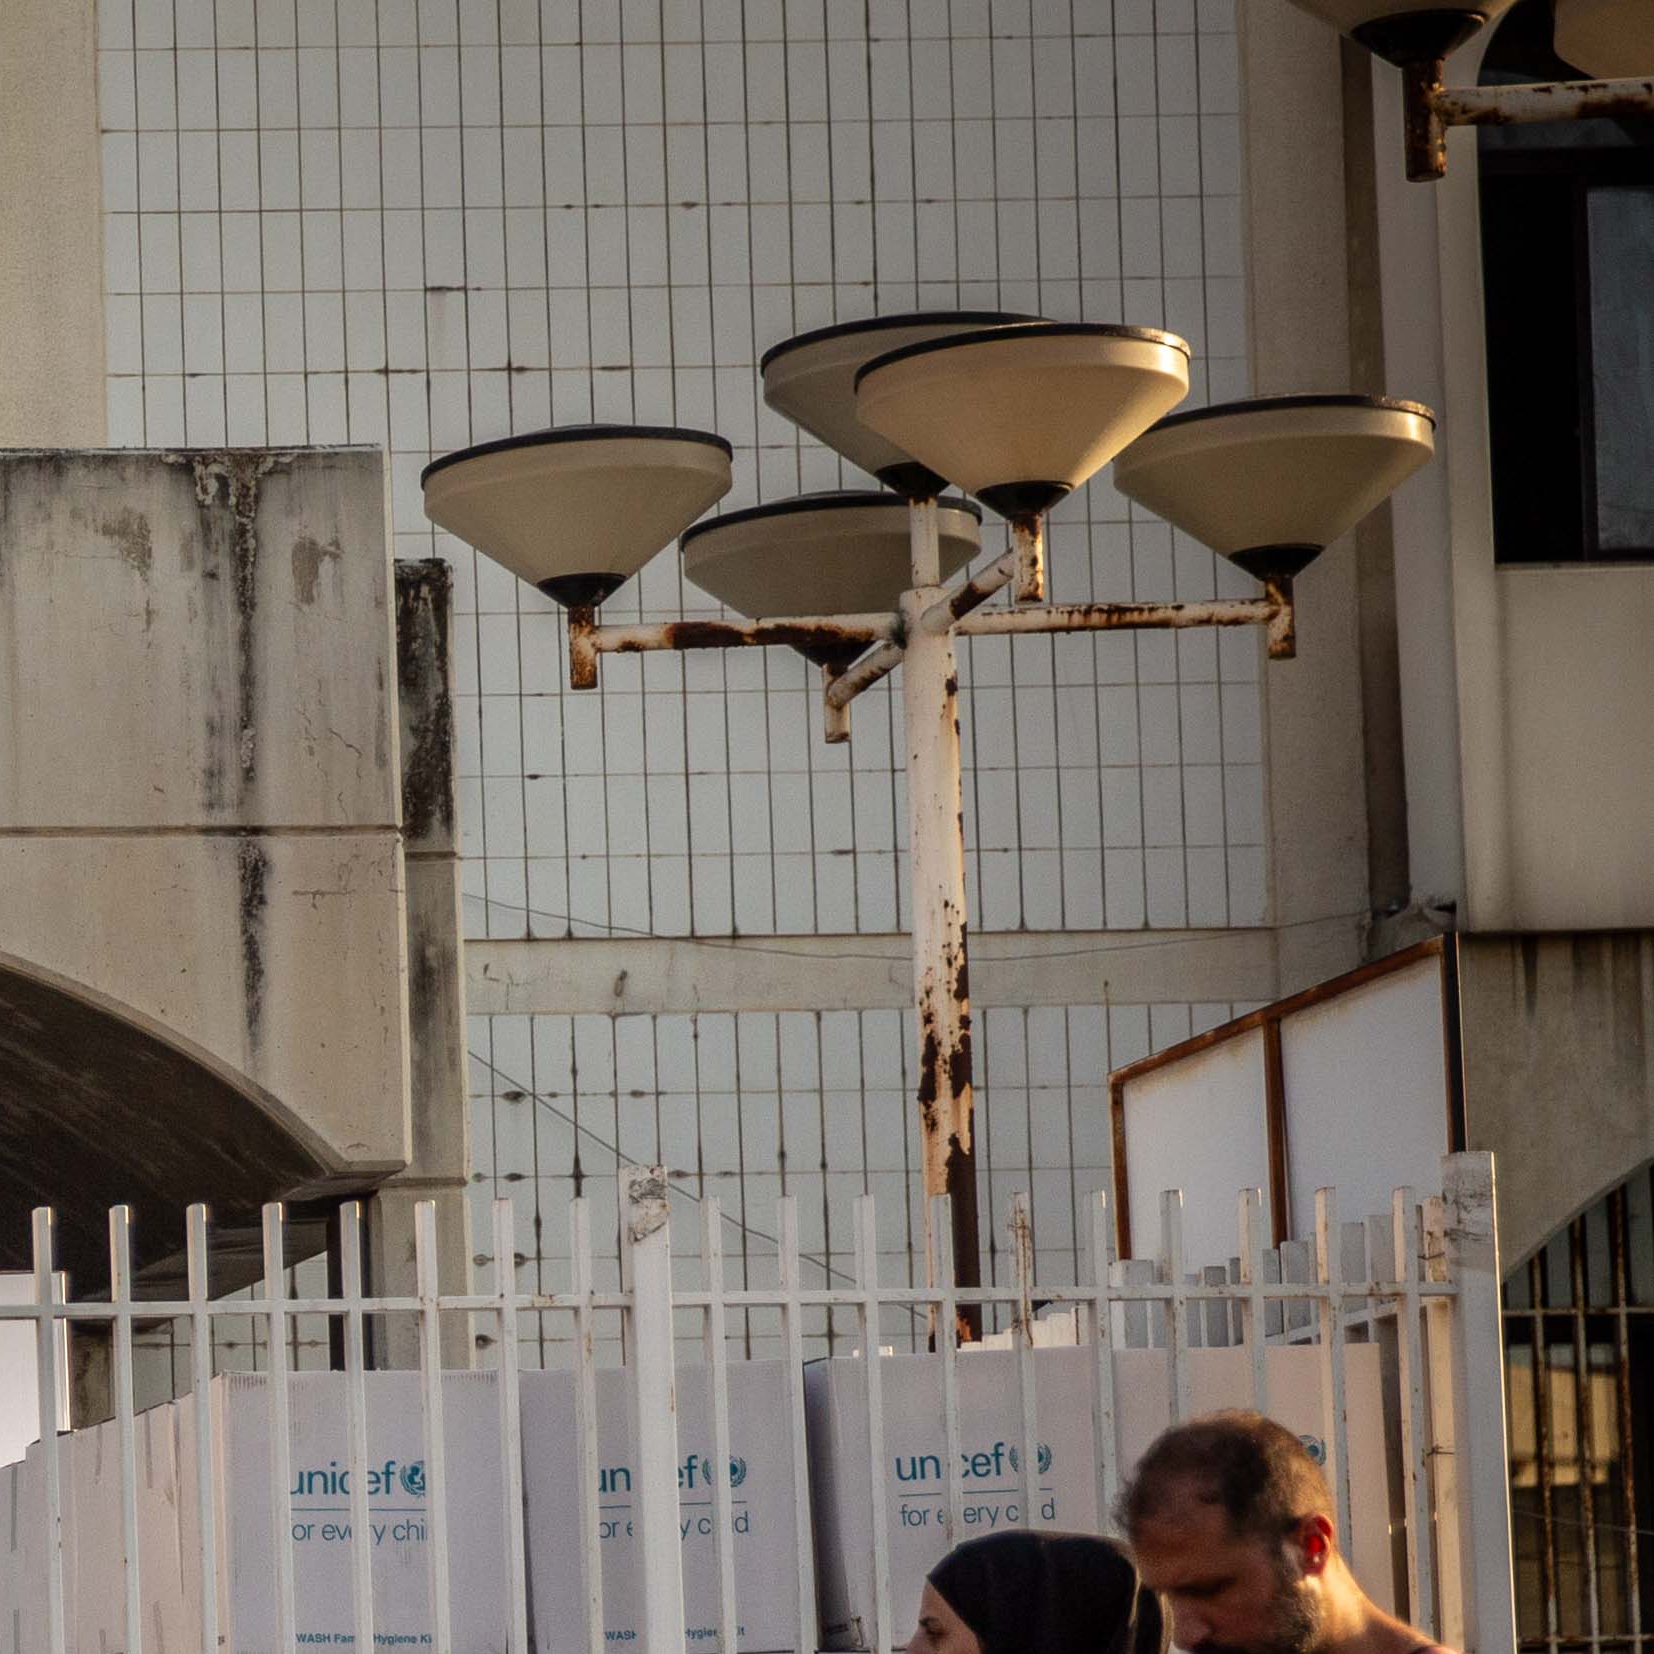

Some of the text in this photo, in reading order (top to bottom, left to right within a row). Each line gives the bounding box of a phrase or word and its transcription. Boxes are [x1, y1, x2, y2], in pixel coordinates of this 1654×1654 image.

[895, 1442, 1005, 1481] unef
[900, 1504, 930, 1527] for
[937, 1506, 1000, 1527] eery
[291, 1522, 316, 1542] or
[322, 1523, 387, 1546] evy
[599, 1521, 618, 1540] or
[296, 1633, 332, 1645] WASH
